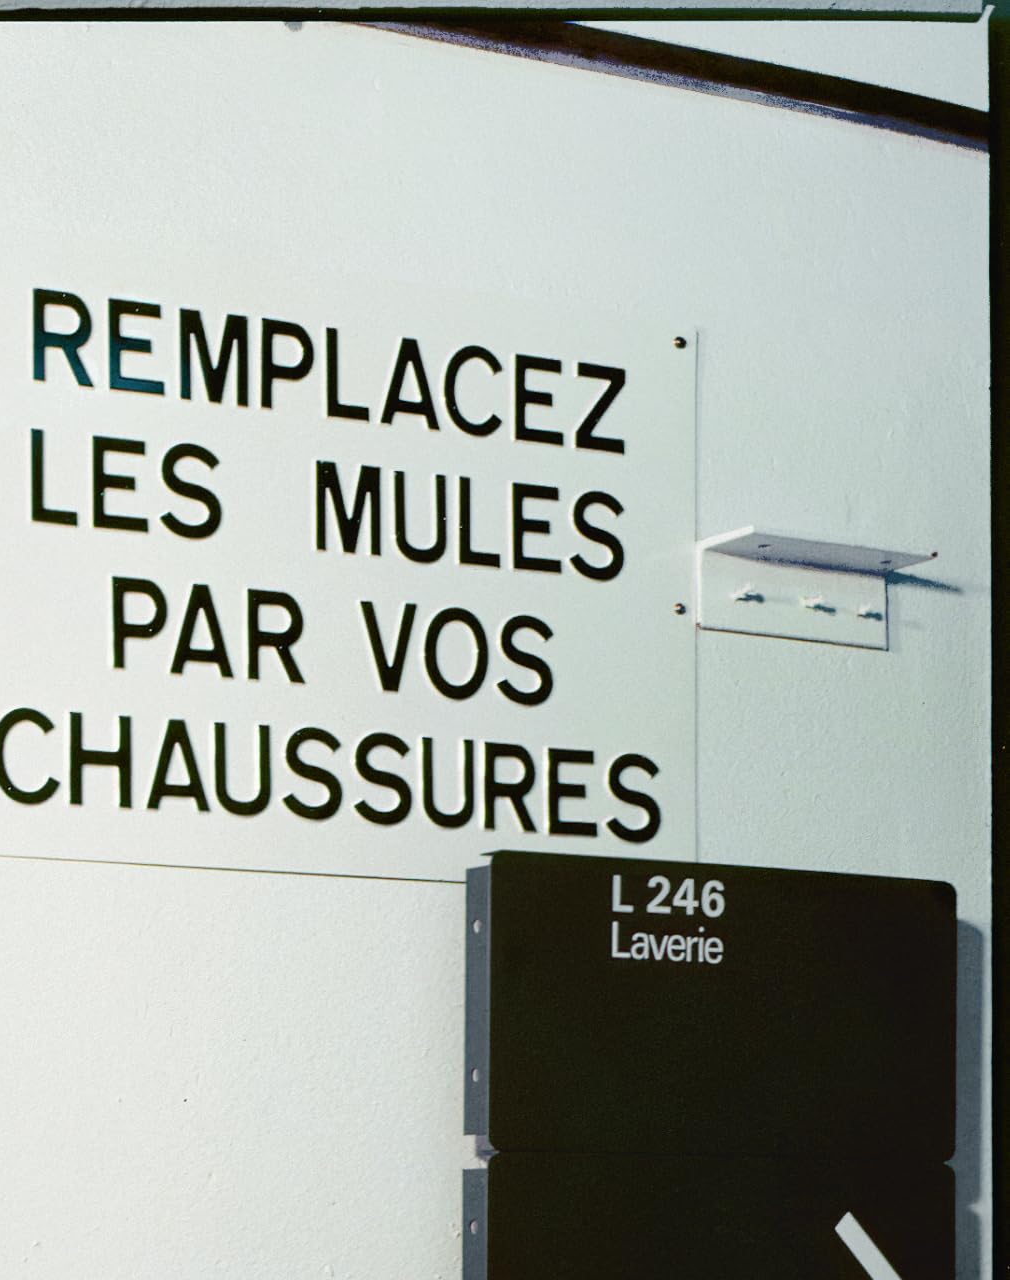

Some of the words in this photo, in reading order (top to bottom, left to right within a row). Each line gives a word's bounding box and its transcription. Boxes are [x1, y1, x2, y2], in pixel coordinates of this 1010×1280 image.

[34, 289, 625, 454] REMPLACEZ
[32, 429, 221, 538] LES
[317, 461, 624, 581] MULES
[113, 577, 304, 683] PAR
[361, 602, 553, 706] VOS
[612, 921, 723, 963] Laverie
[613, 875, 633, 912] L
[647, 876, 724, 917] 246
